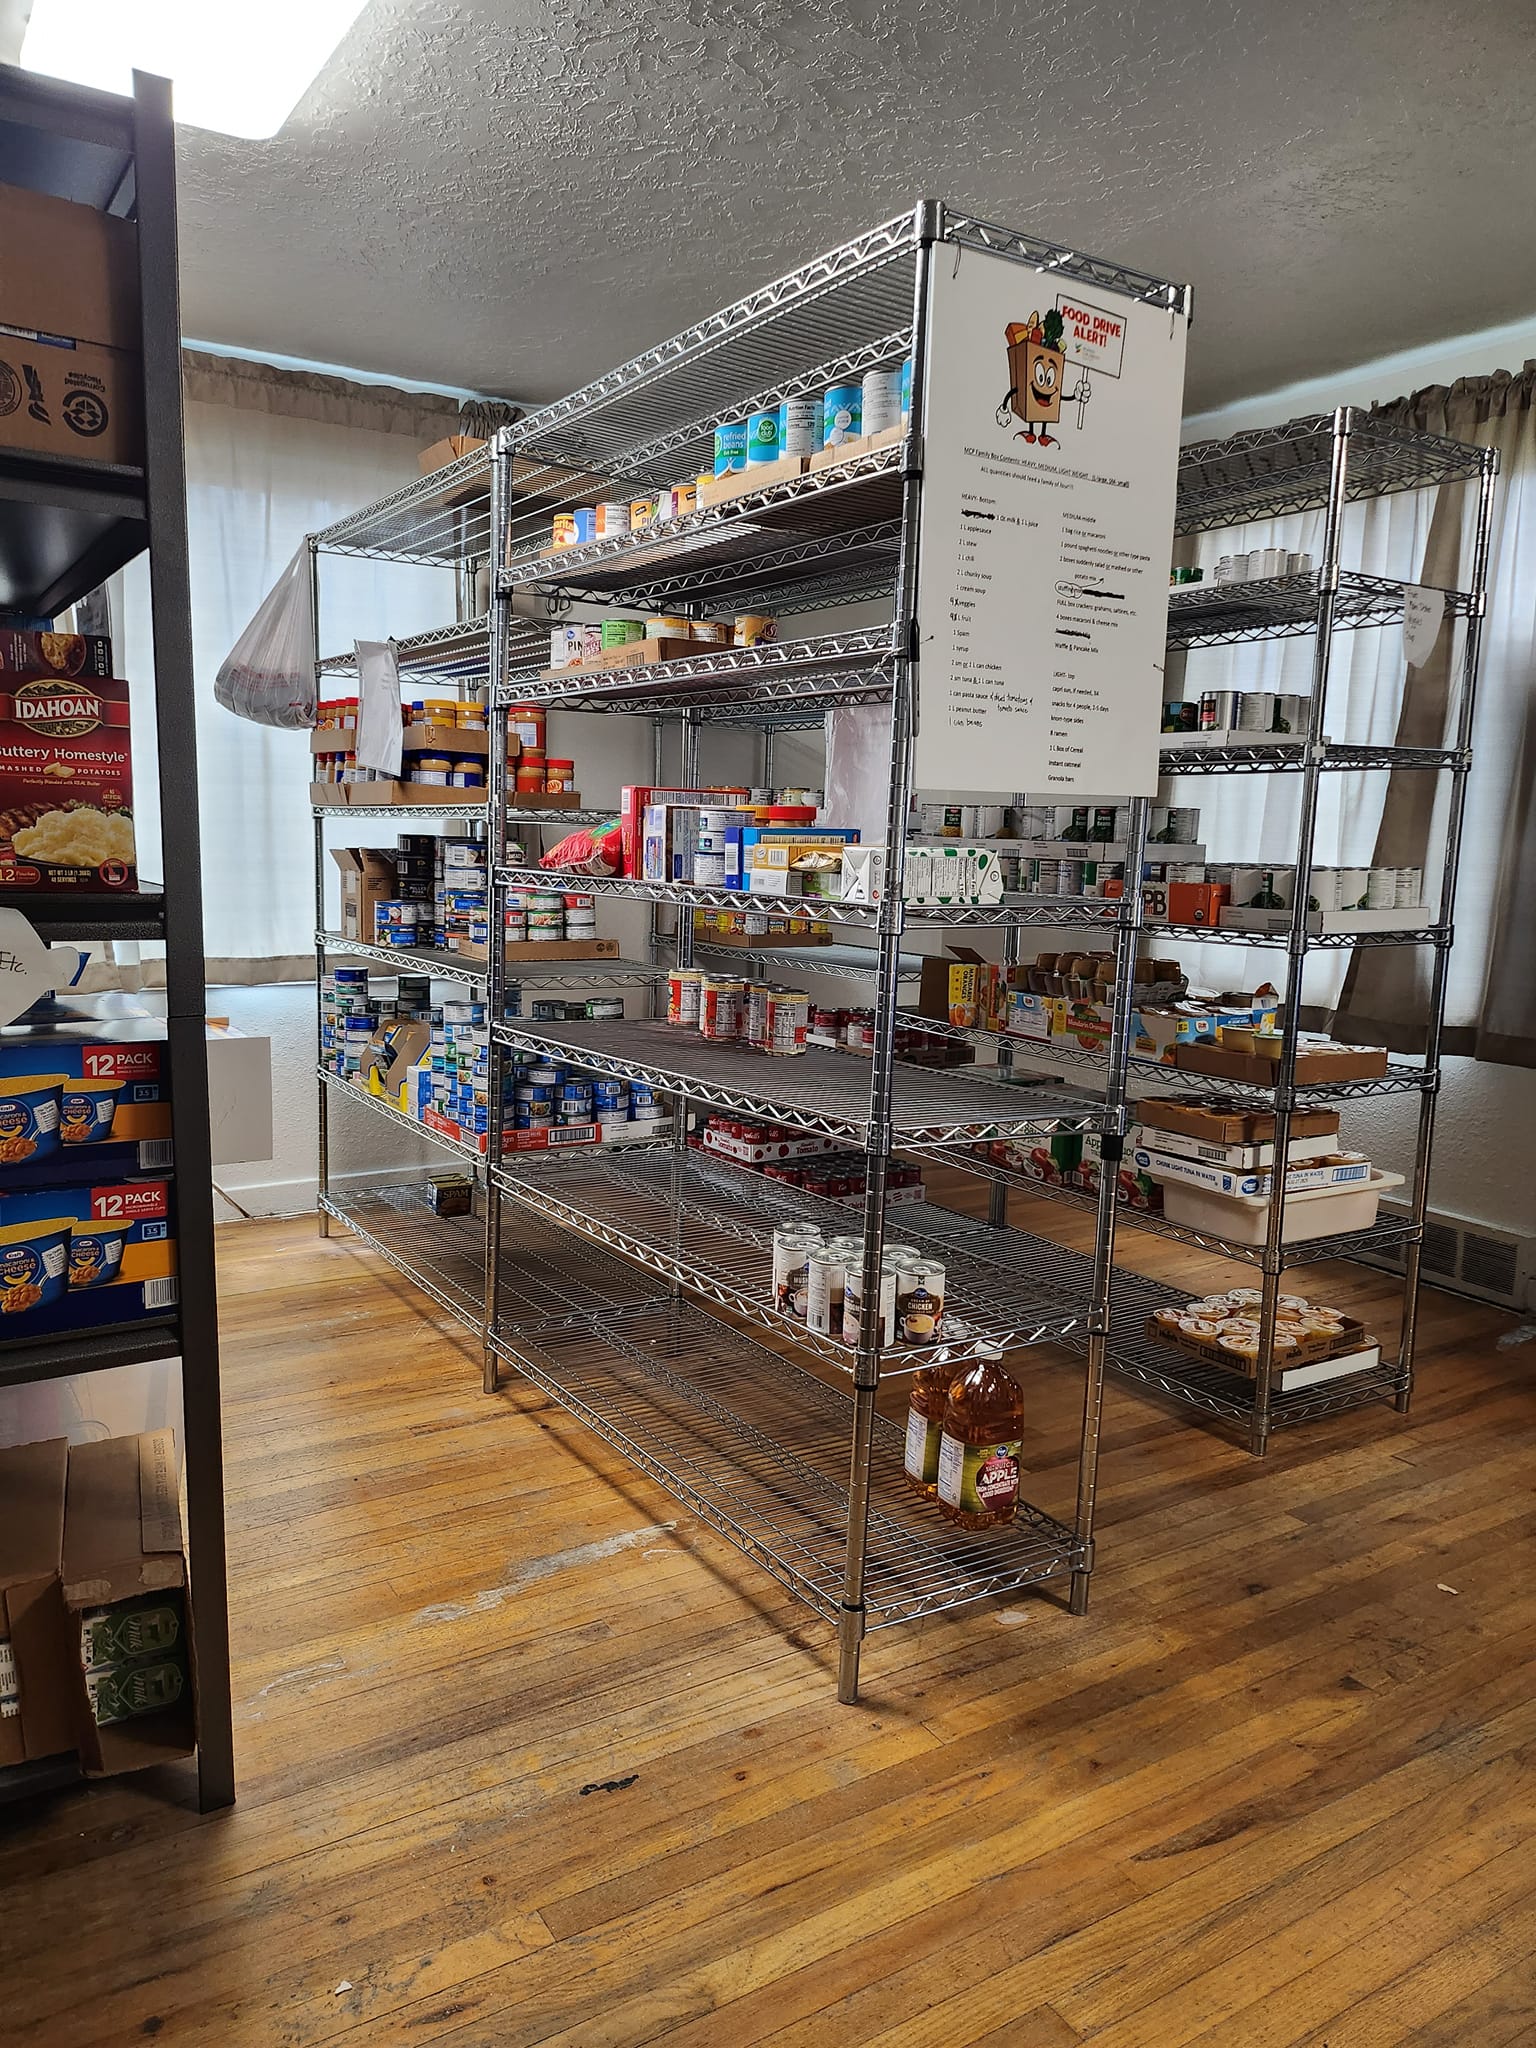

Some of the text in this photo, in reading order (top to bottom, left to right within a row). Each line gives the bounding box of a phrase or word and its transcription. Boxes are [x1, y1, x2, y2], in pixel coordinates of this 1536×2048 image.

[1062, 305, 1121, 338] FOOD DRIVE
[1073, 325, 1107, 347] ALERT!
[761, 423, 773, 432] food
[723, 431, 746, 442] refried
[761, 430, 772, 438] club
[723, 440, 744, 450] beans
[1078, 545, 1097, 553] spaghetti
[1076, 559, 1094, 567] suddenly
[964, 571, 980, 579] chunky
[975, 587, 986, 595] soup
[959, 600, 976, 608] veggies
[15, 698, 99, 718] IDAHOAN
[54, 747, 125, 764] Homestyle
[0, 952, 27, 975] Etc.
[961, 970, 969, 1001] ORANGES
[1067, 1018, 1088, 1031] Mandarin
[85, 1054, 115, 1076] 12
[116, 1052, 153, 1065] PACK
[0, 1112, 21, 1120] caroni
[796, 1145, 818, 1154] Tomato
[1171, 1163, 1183, 1172] LIGHT
[1184, 1167, 1196, 1175] TUNA
[1201, 1172, 1216, 1181] WATER
[443, 1188, 468, 1199] SPAM
[94, 1190, 161, 1218] 12 PACK
[908, 1302, 933, 1311] CHICKEN
[981, 1466, 1018, 1485] APPLE
